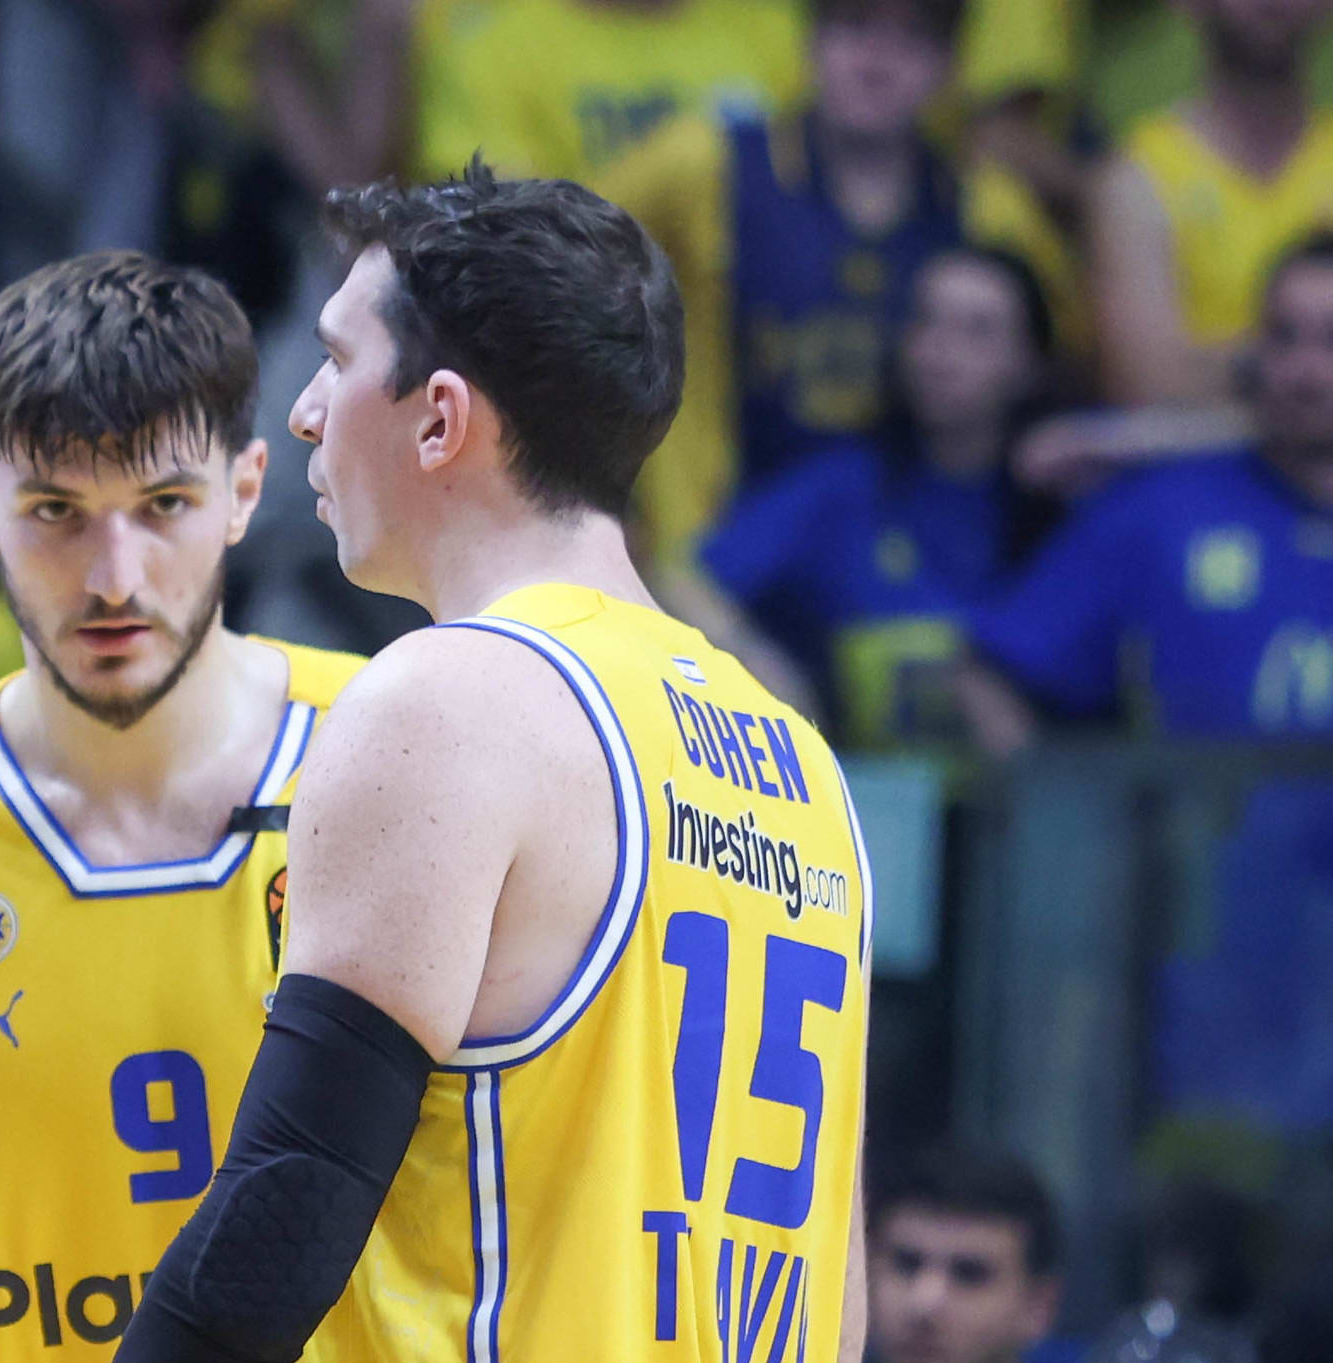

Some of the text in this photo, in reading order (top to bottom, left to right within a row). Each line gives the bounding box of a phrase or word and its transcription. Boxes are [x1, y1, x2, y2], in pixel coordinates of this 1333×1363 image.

[661, 677, 810, 804] COHEN
[663, 779, 847, 920] Investing.com
[110, 1049, 214, 1204] 9
[662, 910, 847, 1230] 15
